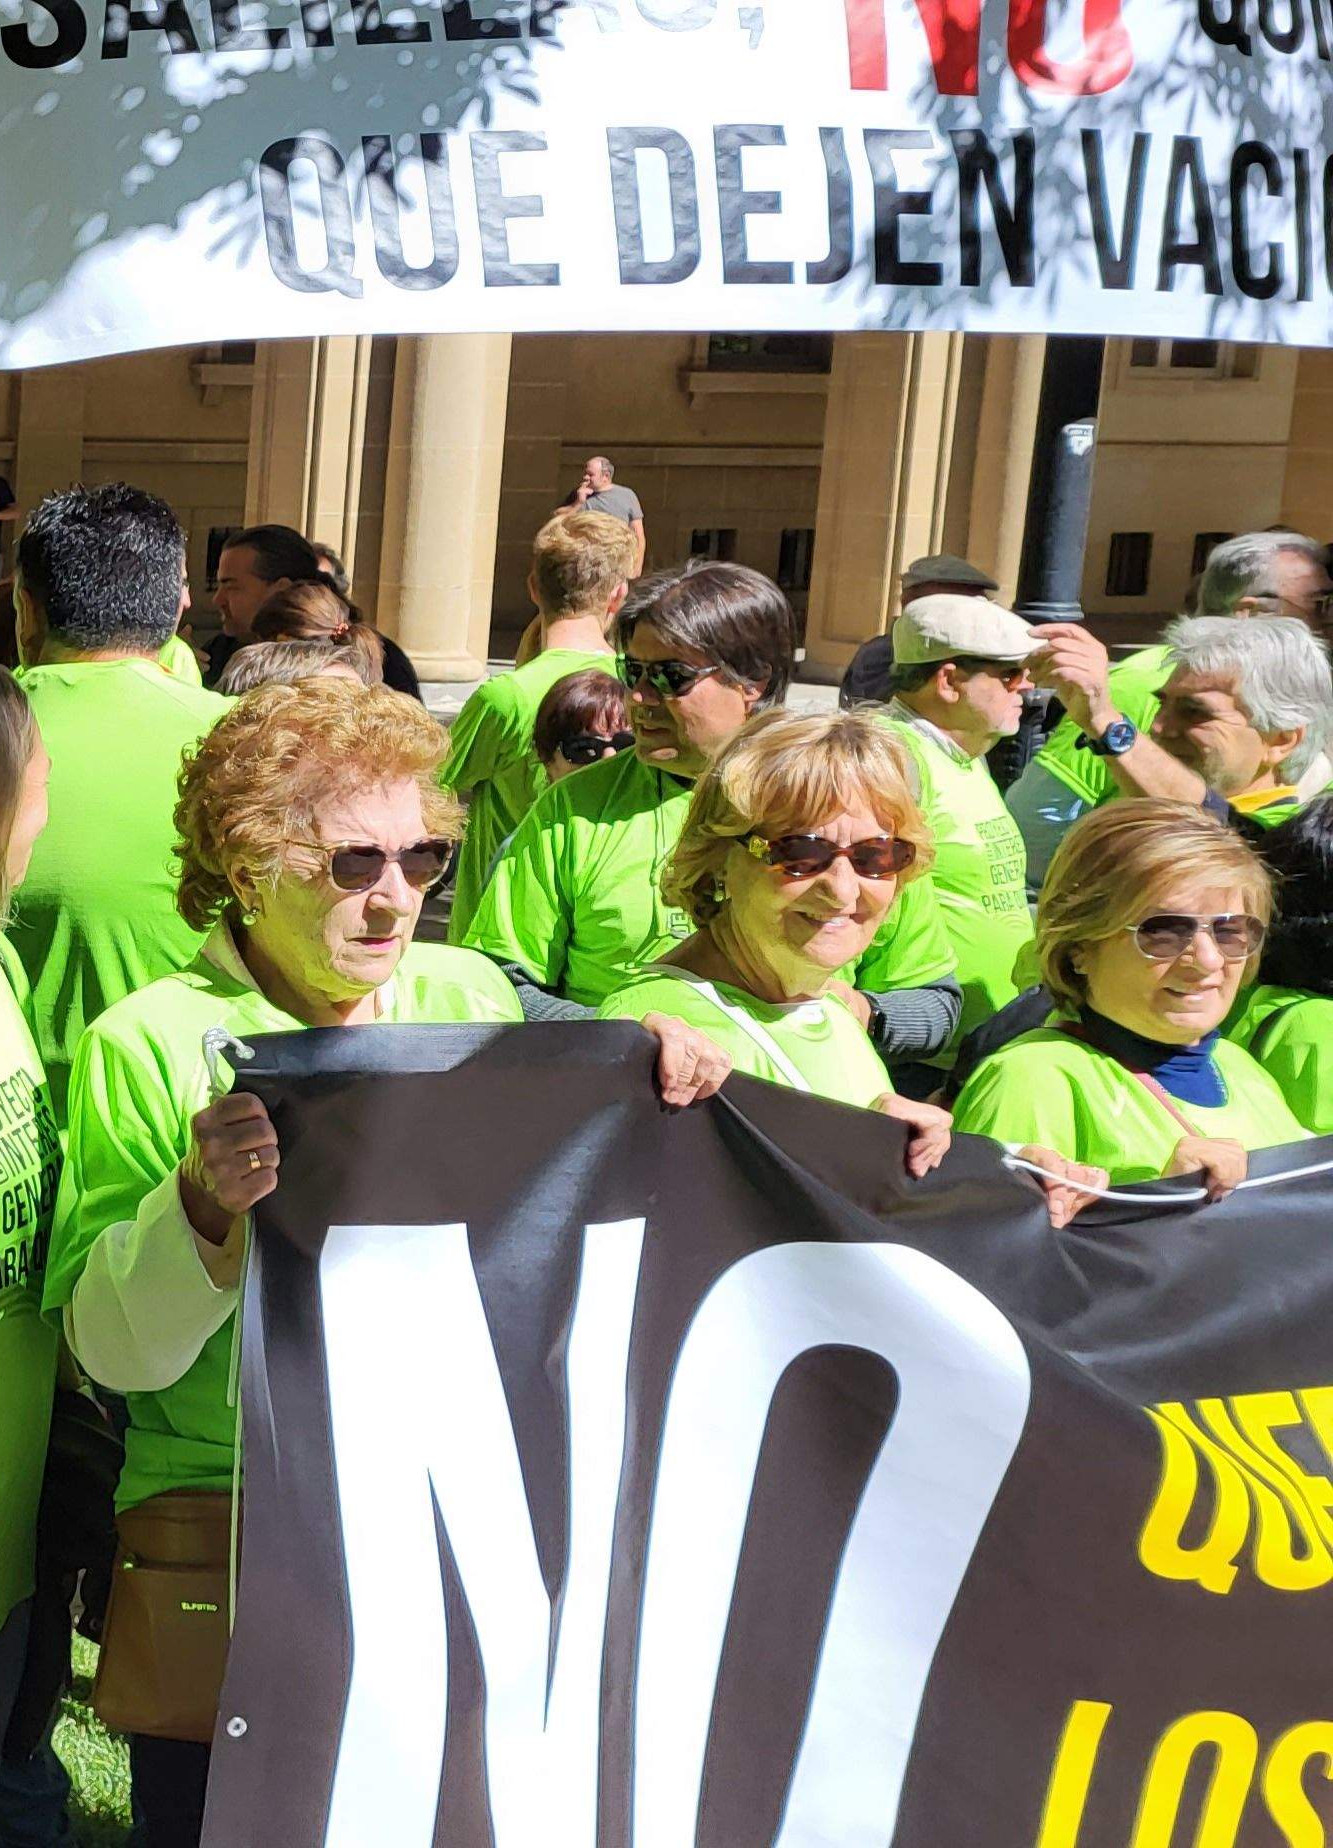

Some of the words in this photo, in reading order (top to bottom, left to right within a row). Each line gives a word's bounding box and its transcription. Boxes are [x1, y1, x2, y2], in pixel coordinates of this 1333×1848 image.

[258, 128, 561, 300] QUE
[605, 123, 1035, 288] DEJEN
[1079, 127, 1333, 302] VACI
[320, 1217, 1030, 1848] NO
[1139, 1386, 1333, 1595] QUE
